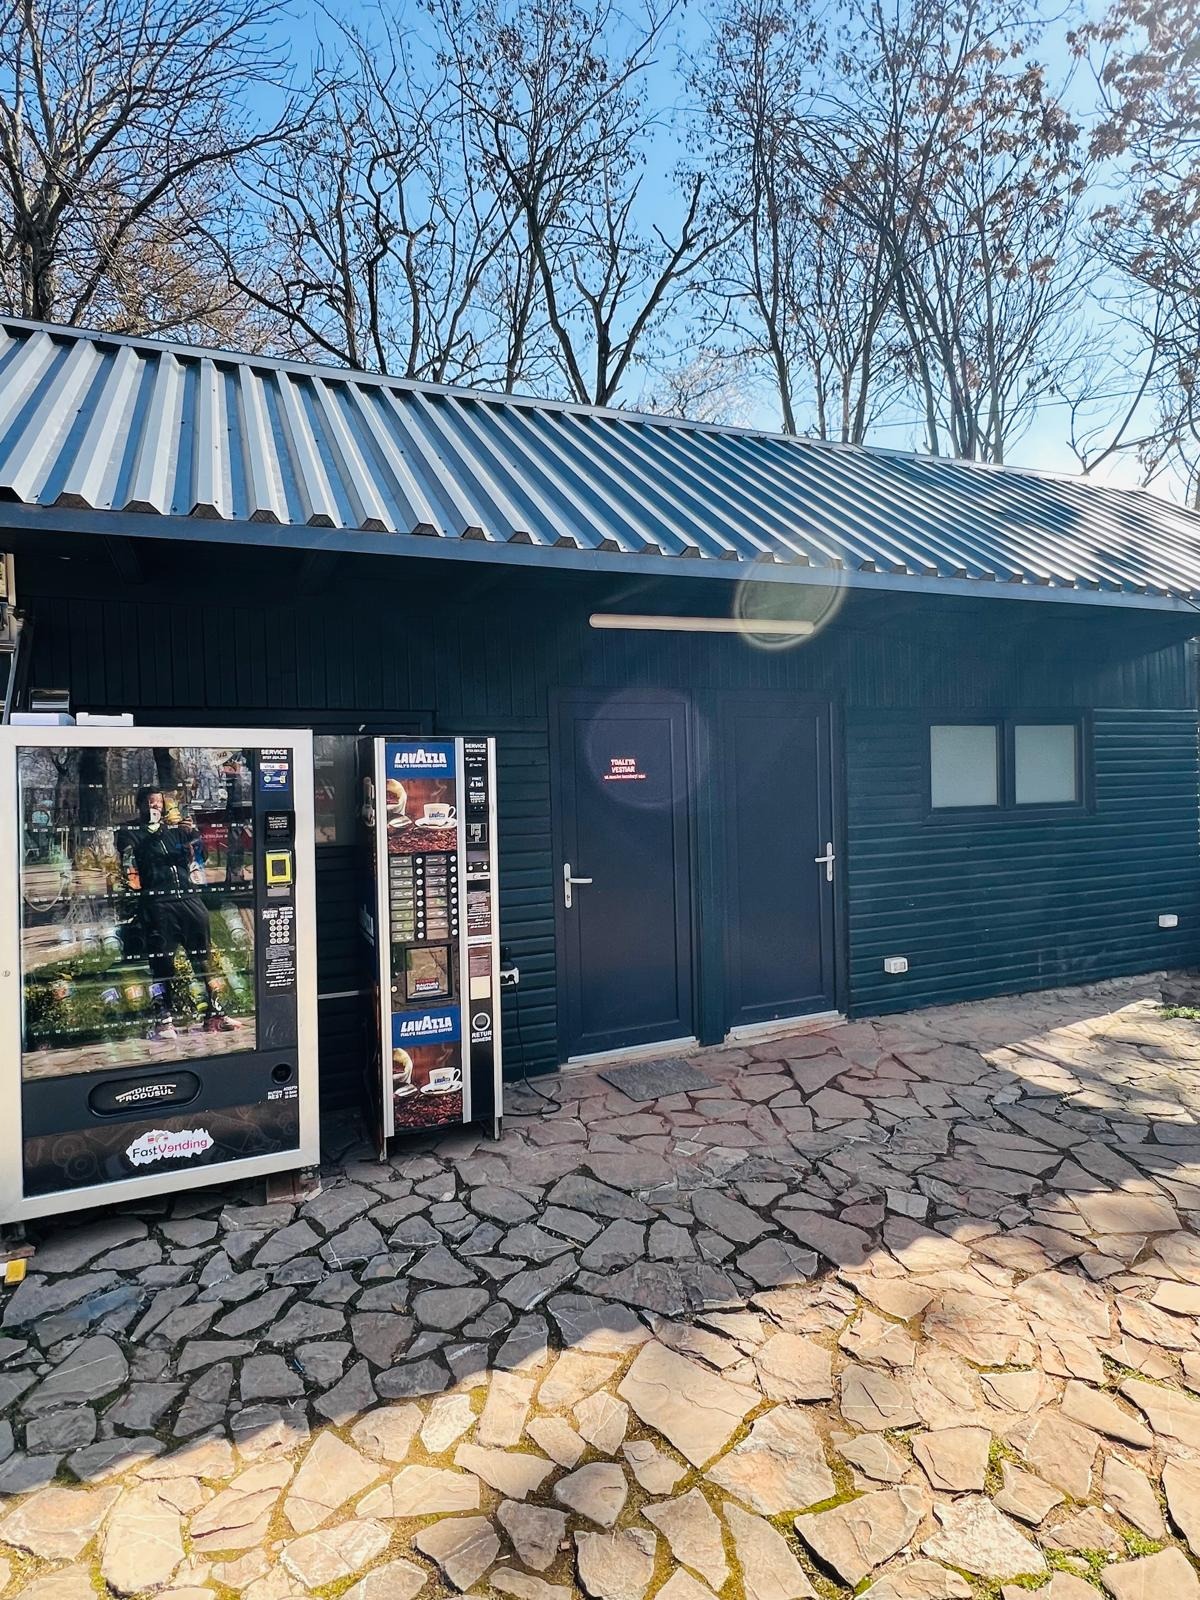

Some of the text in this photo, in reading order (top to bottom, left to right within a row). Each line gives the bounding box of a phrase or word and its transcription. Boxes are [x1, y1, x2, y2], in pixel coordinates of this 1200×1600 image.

[394, 749, 447, 764] LAVAZZA
[400, 1015, 453, 1033] LAVAZZA
[471, 1030, 493, 1038] RETUR
[119, 1088, 174, 1102] PRODUSUL
